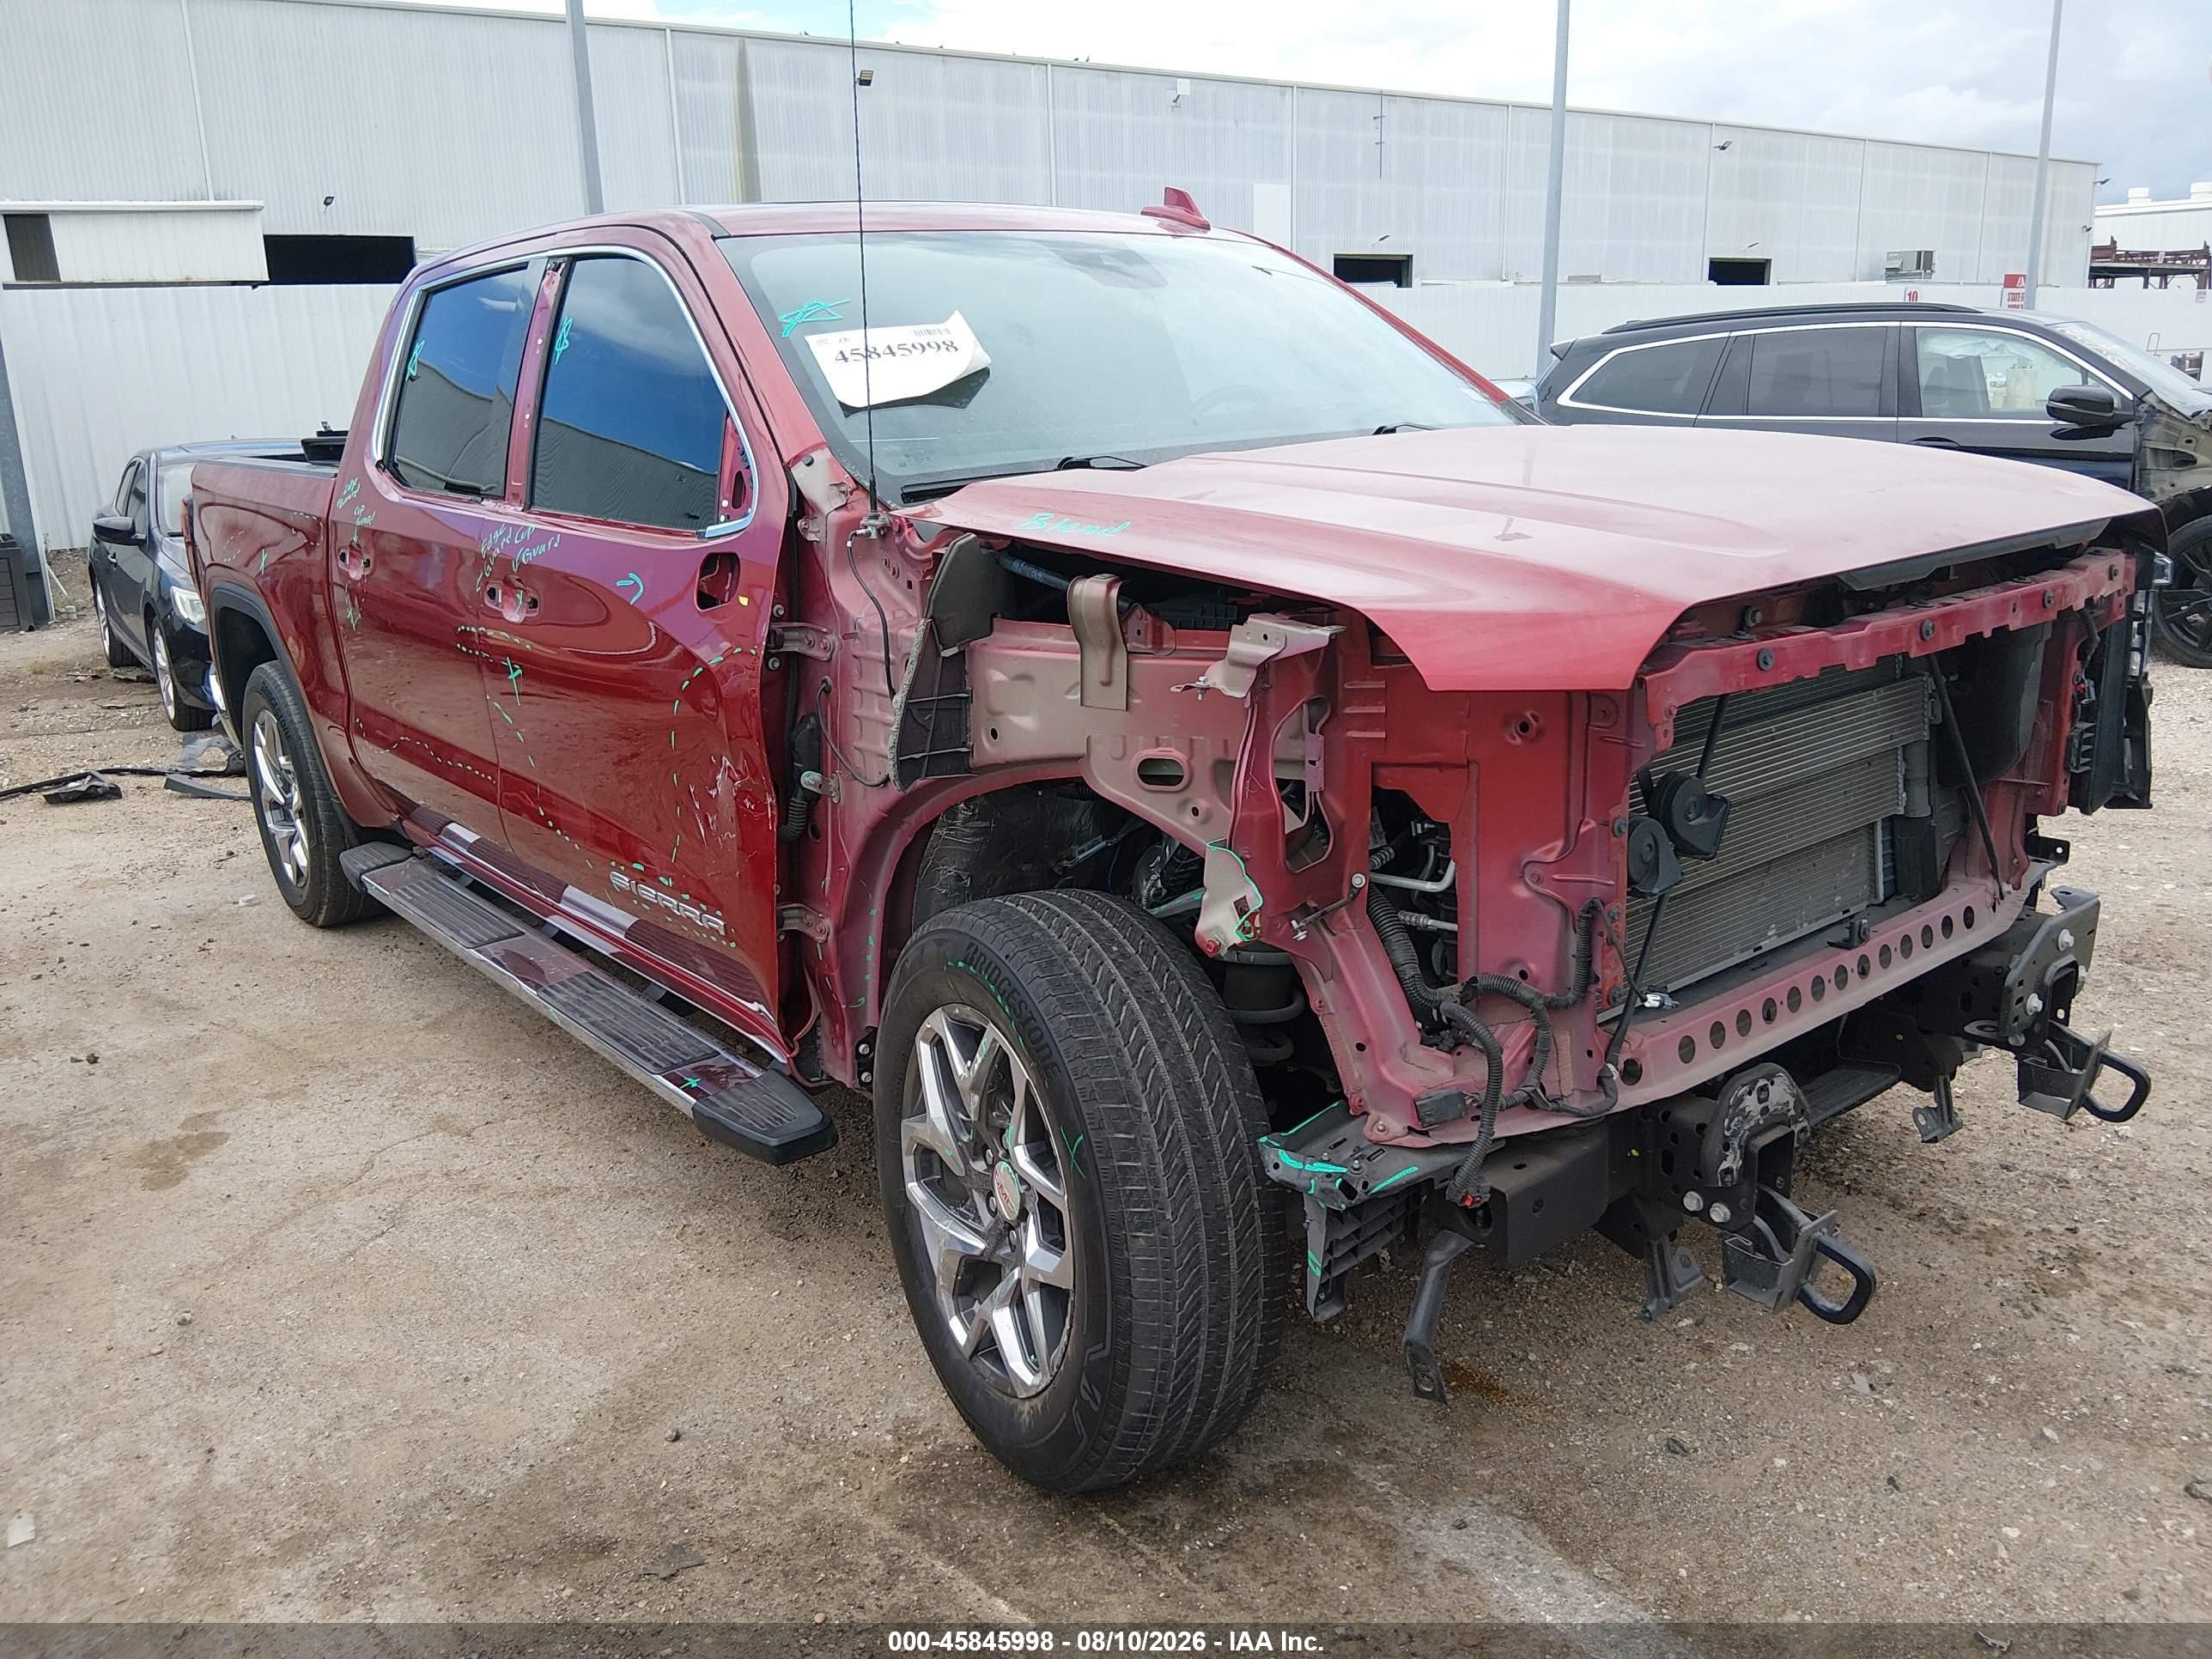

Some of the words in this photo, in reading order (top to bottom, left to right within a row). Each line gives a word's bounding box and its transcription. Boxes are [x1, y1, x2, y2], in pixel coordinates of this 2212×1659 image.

[1906, 290, 1918, 302] 10
[835, 339, 959, 364] 45845998
[1015, 510, 1132, 538] Blend
[609, 871, 726, 936] SIERRA
[963, 941, 1062, 1079] BRIDGESTONE
